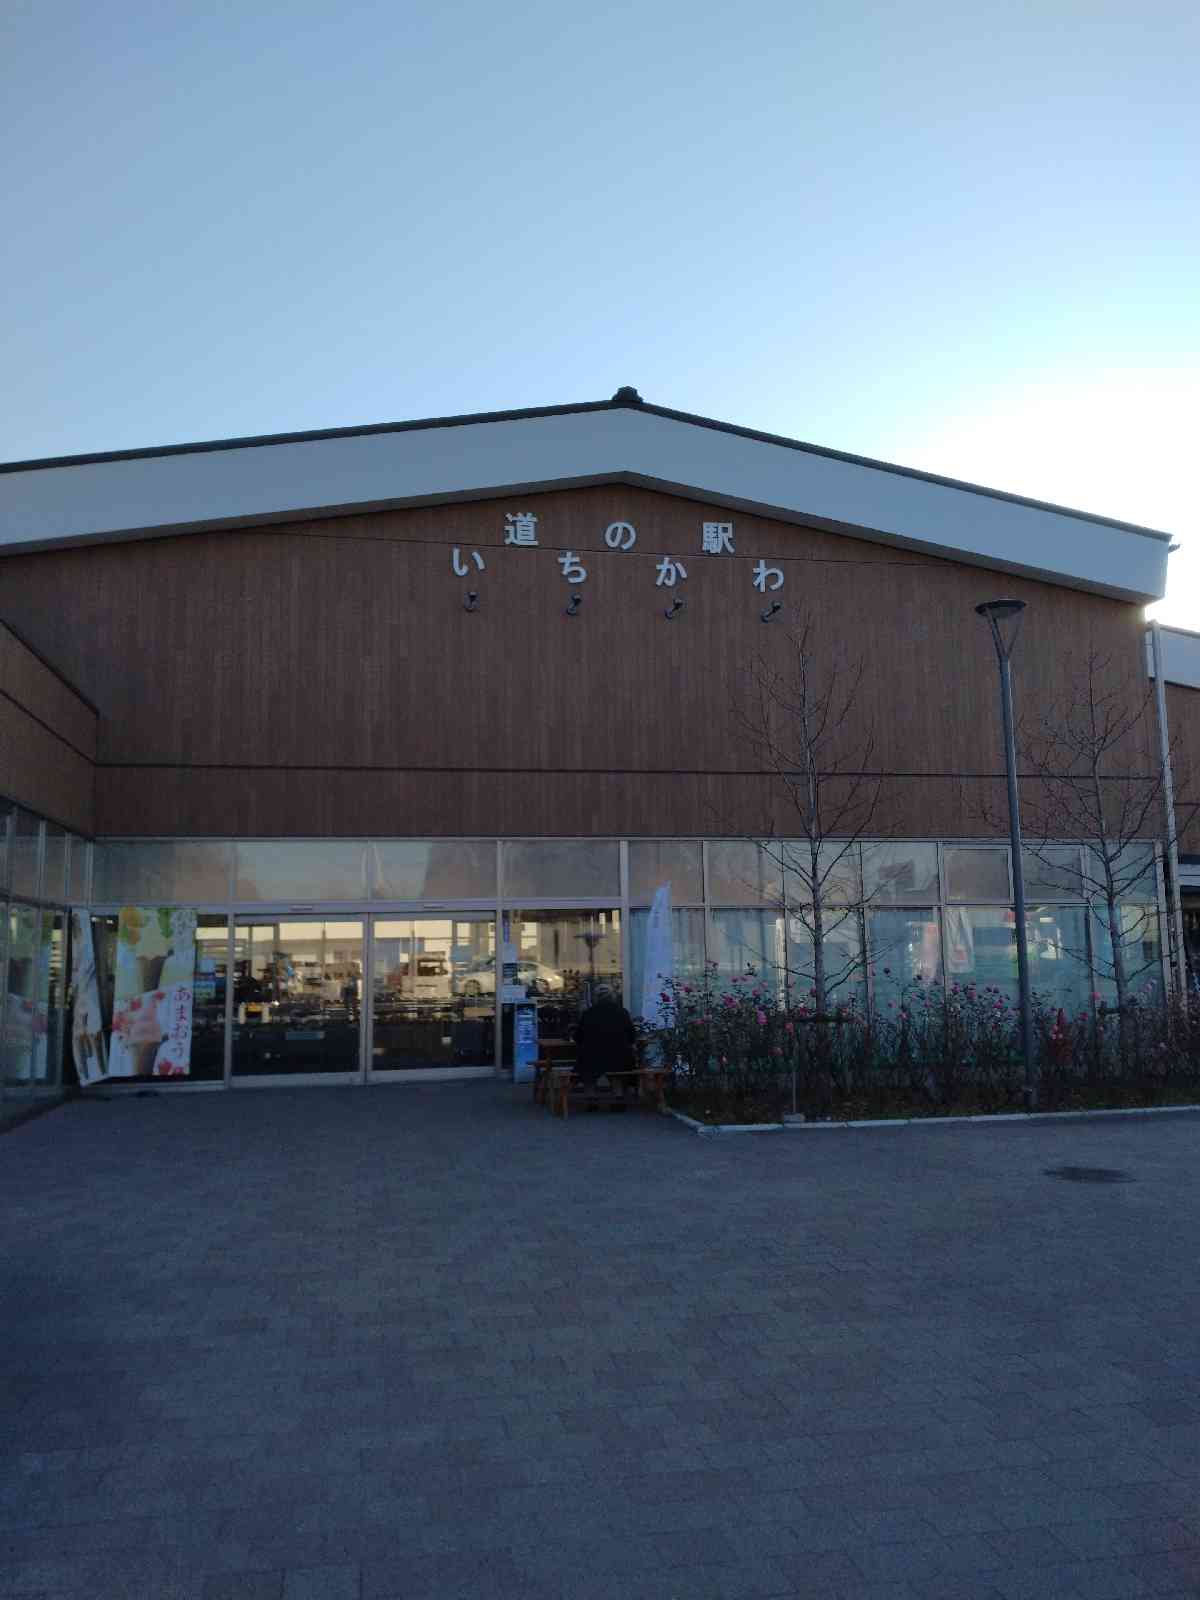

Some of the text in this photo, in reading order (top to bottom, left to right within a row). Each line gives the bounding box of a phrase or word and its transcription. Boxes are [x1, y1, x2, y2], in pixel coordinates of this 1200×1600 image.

[503, 512, 736, 555] 道の駅
[452, 547, 785, 593] いちかわ
